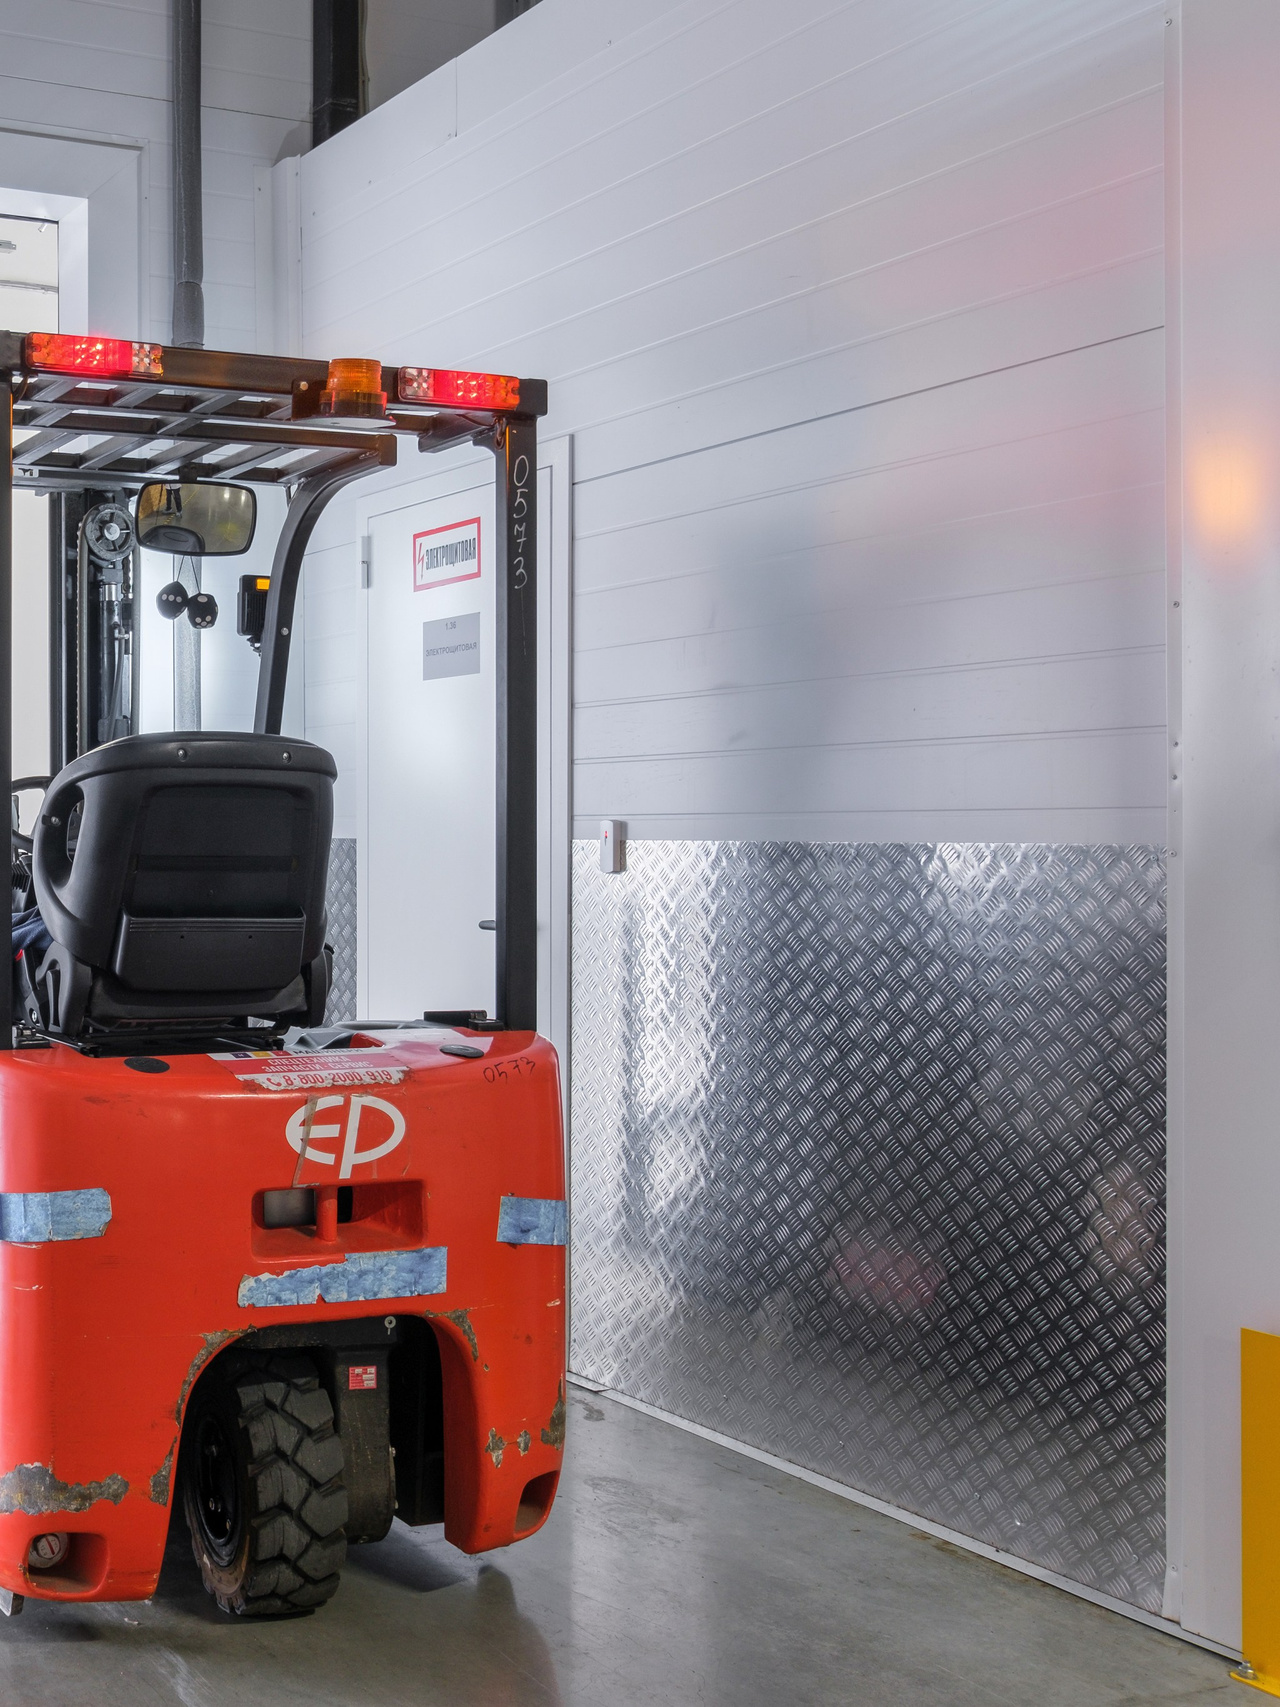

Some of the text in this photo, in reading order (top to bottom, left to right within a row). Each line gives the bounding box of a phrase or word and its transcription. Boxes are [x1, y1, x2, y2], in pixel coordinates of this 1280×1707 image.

[425, 537, 477, 571] ЭЛЕКТРОЩИТОВАЯ
[425, 641, 478, 657] ЭЛЕКТРОЩИТОВАЯ
[261, 1060, 374, 1073] ЗАПЧАСТИ СЕРВИС
[267, 1055, 352, 1066] СПЕЦТЕХНИКА
[483, 1056, 536, 1085] 0573
[285, 1093, 406, 1179] EP
